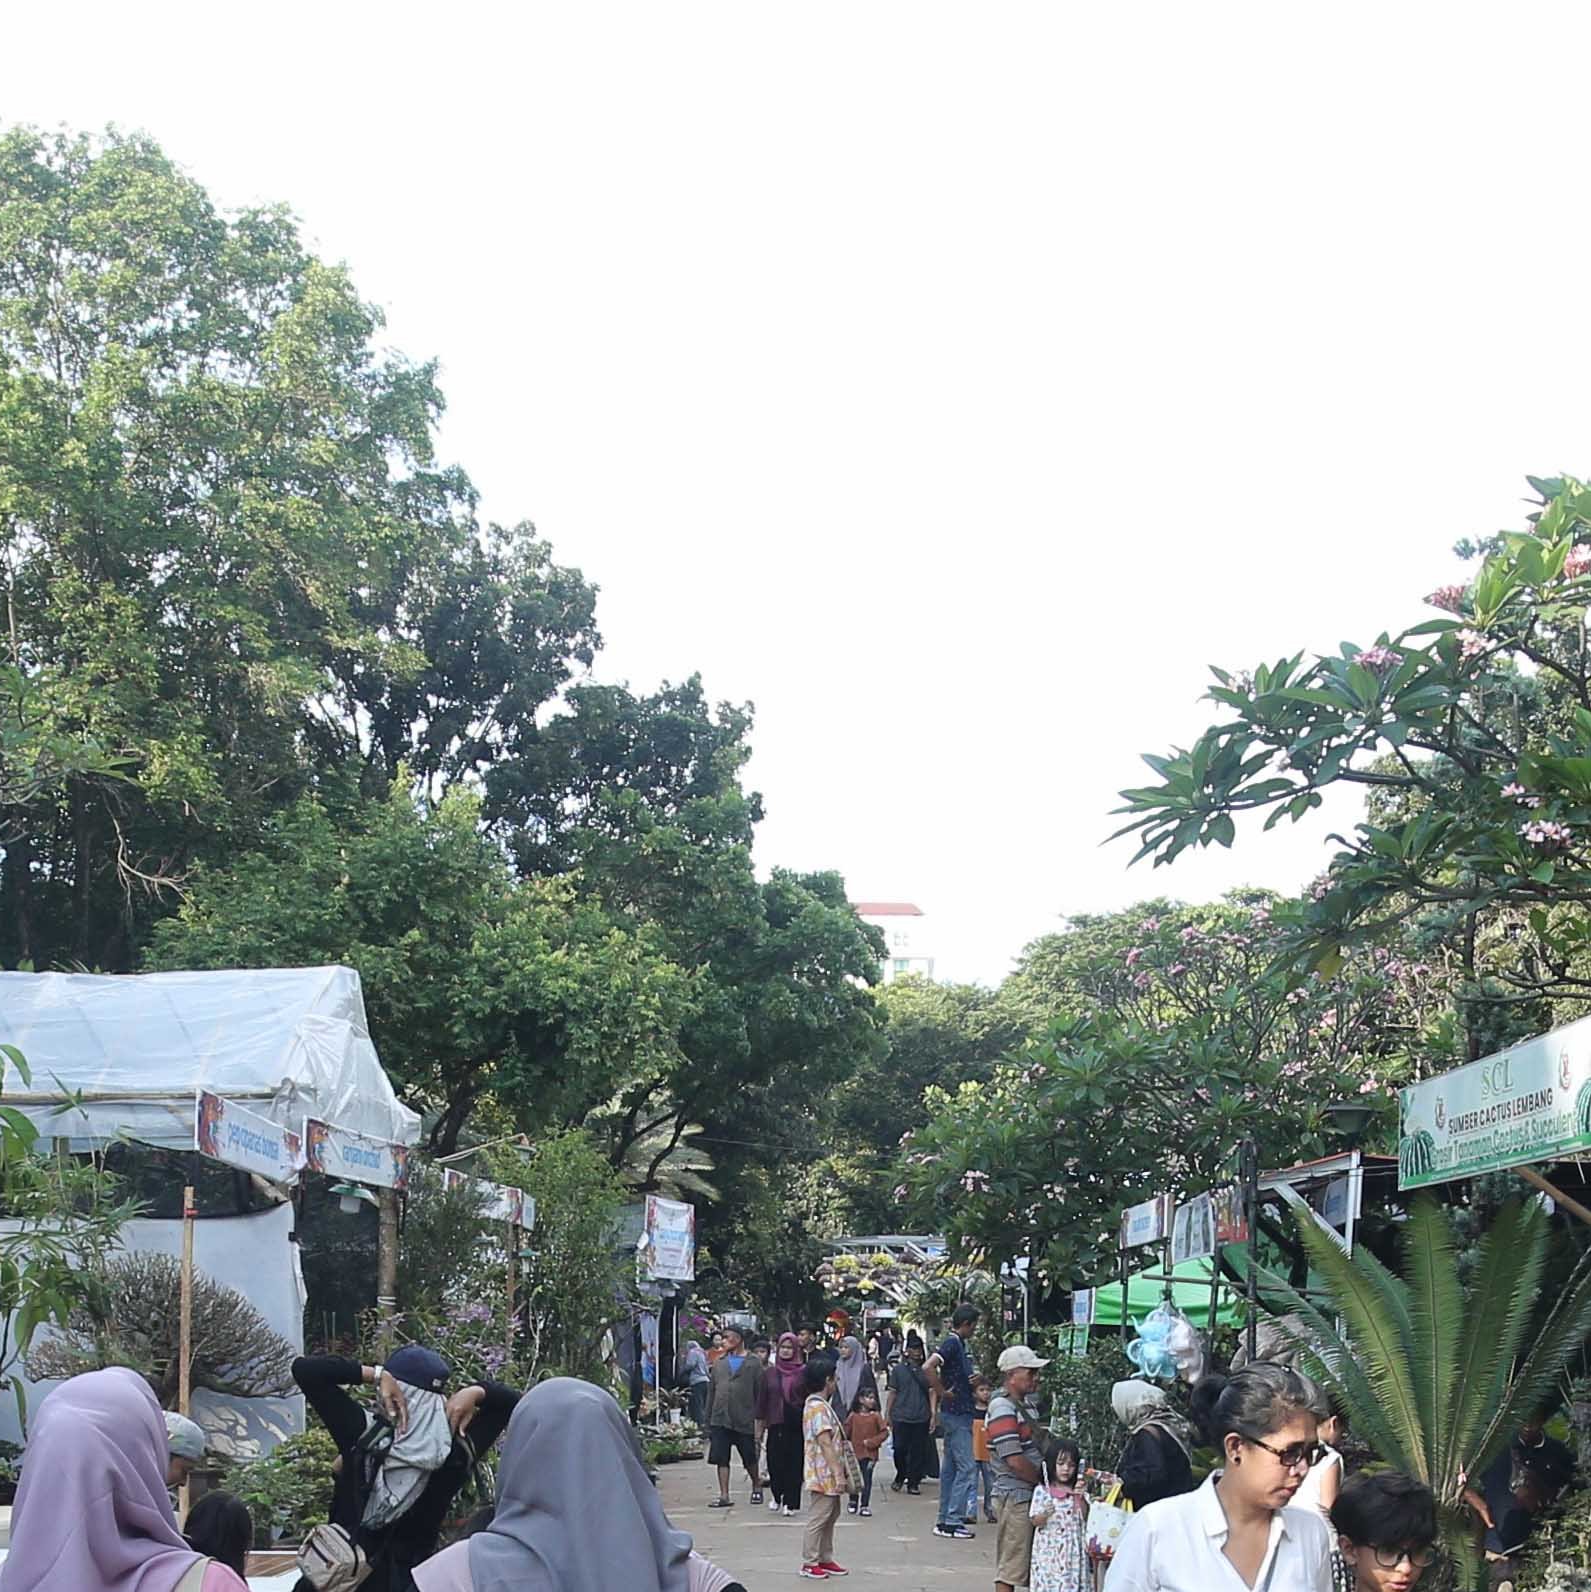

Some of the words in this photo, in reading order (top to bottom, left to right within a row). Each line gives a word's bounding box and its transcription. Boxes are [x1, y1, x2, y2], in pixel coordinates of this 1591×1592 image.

[1481, 1058, 1514, 1096] SCL
[1448, 1110, 1478, 1134] SUMBER
[1480, 1101, 1512, 1124] CACTUS
[1513, 1088, 1553, 1117] LEMBANG
